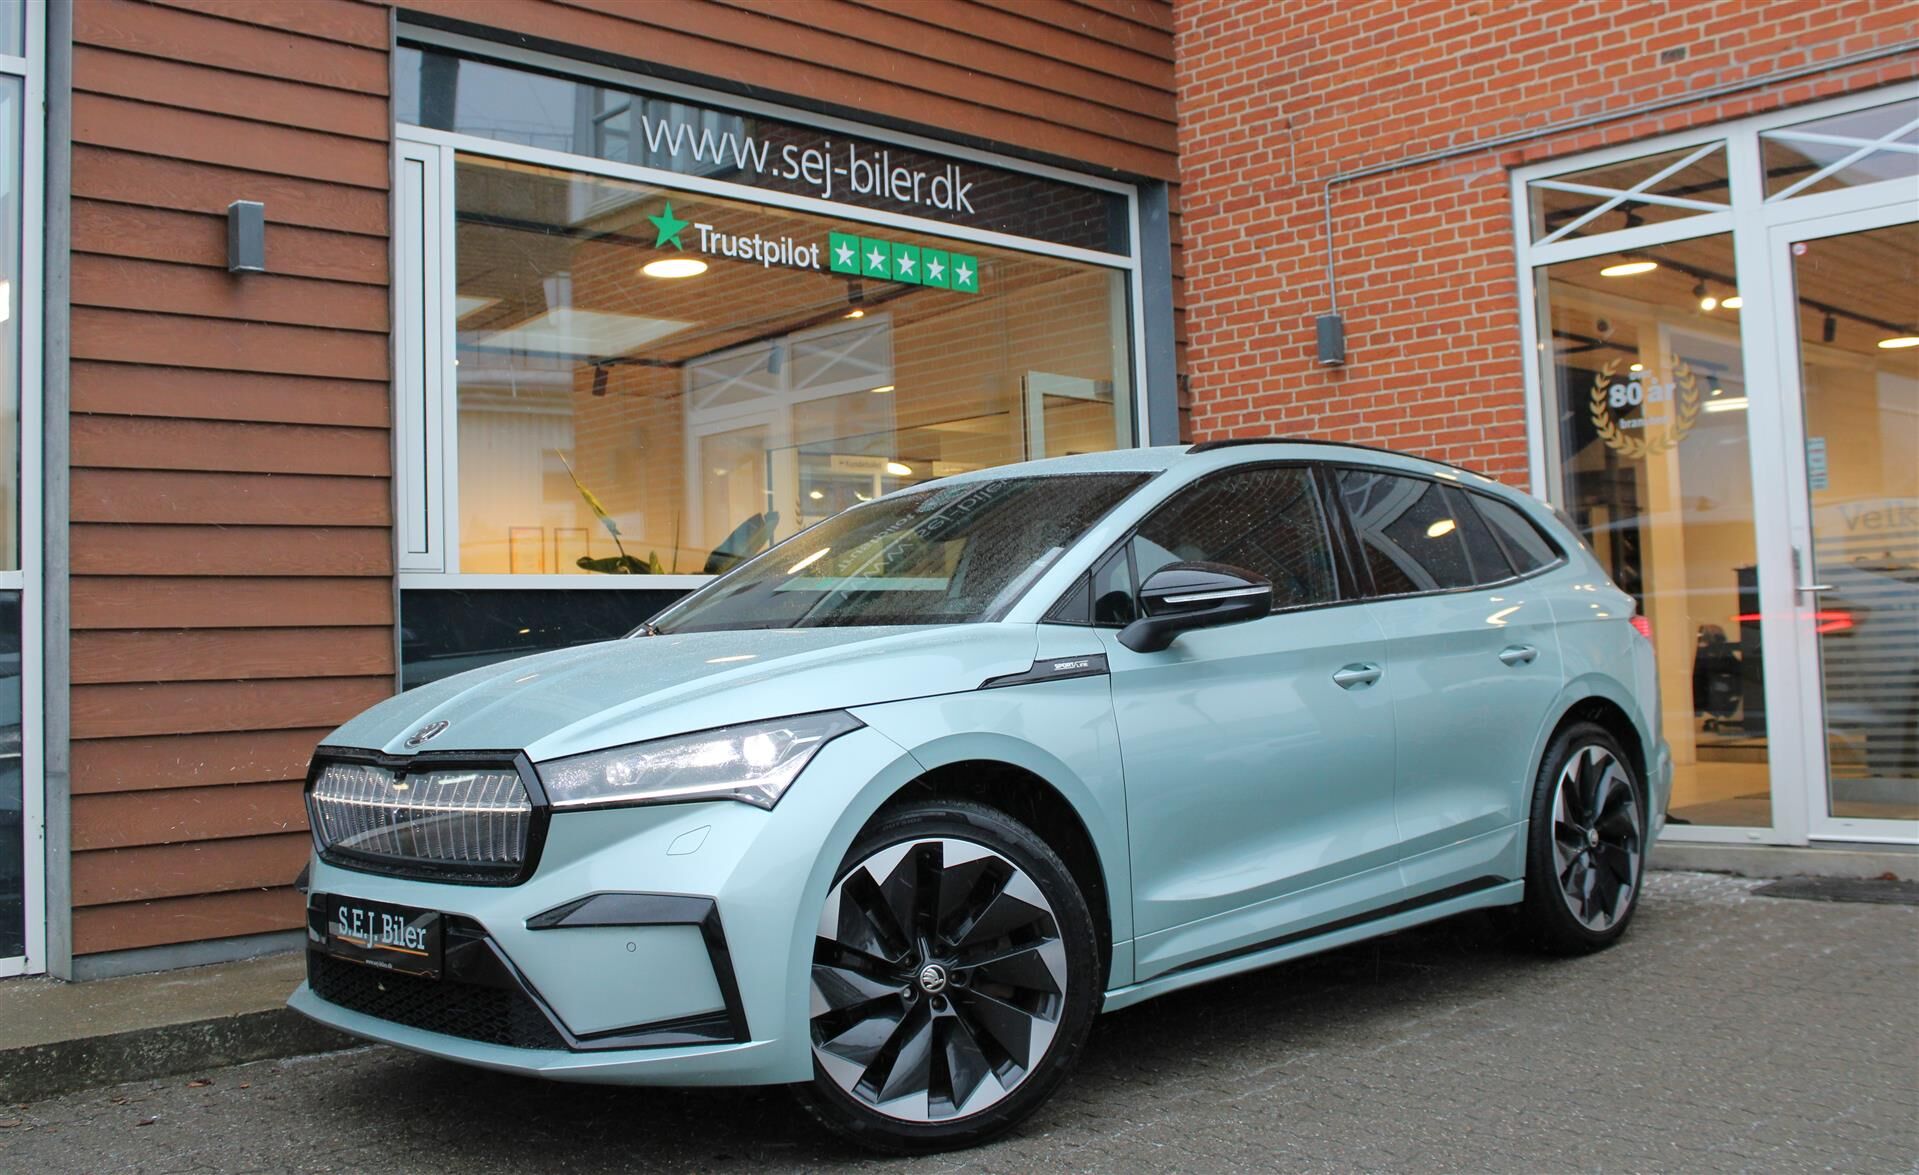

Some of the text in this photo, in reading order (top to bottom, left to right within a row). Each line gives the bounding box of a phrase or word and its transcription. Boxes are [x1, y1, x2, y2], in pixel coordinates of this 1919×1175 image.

[641, 115, 976, 215] www.sej-biler.dk
[694, 222, 821, 270] Trustpilot
[1608, 377, 1677, 408] 80 år
[338, 905, 427, 950] S.E.J. Biler
